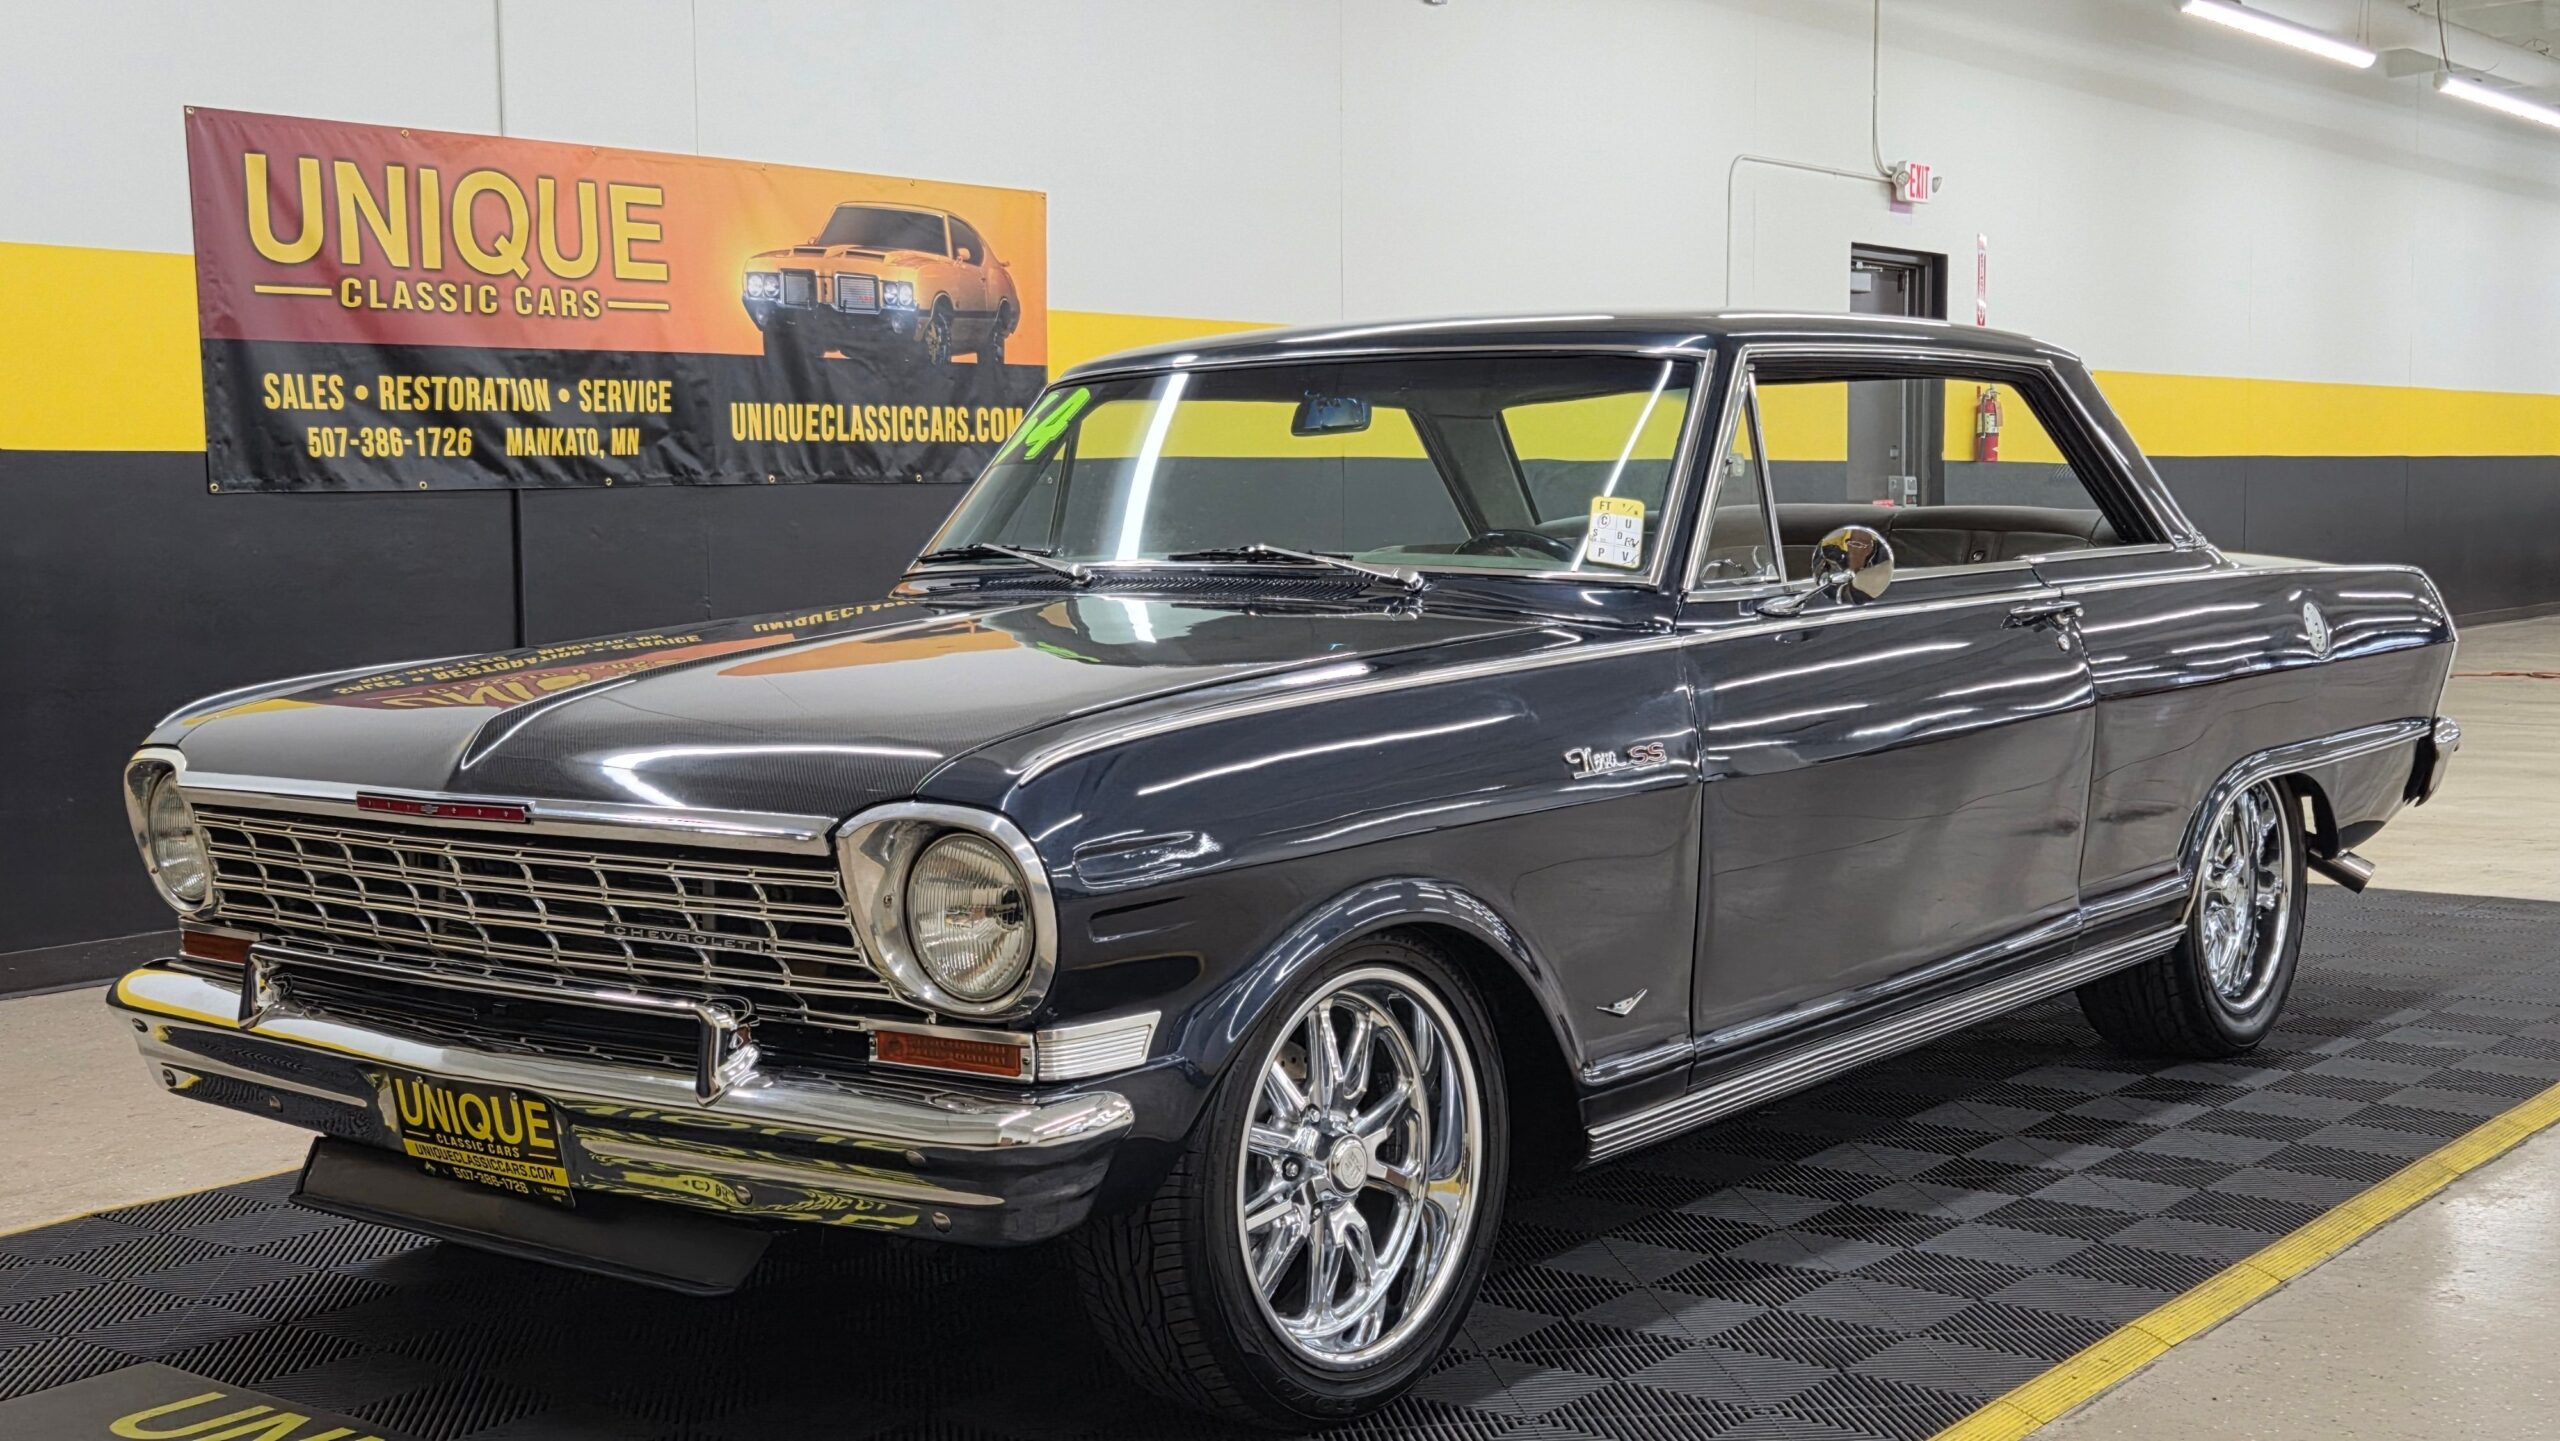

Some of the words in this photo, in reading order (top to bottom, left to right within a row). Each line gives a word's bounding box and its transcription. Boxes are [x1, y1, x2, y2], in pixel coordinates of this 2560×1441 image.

[1909, 163, 1930, 199] EXIT
[244, 153, 668, 281] UNIQUE
[341, 277, 498, 314] CLASSIC
[515, 287, 600, 318] CARS
[263, 373, 344, 410] SALES
[378, 375, 552, 412] RESTORATION
[579, 379, 672, 413] SERVICE
[307, 426, 472, 458] 507-386-1726
[611, 427, 640, 456] MN
[730, 402, 1024, 443] UNIQUECLASSICCARS.COM
[1629, 742, 1667, 765] SS
[612, 926, 752, 950] CHEVROLET
[395, 1078, 556, 1149] UNIQUE
[415, 1143, 556, 1182] UNIQUECLASSICCARS.COM
[436, 1133, 484, 1152] CLASSIC
[488, 1143, 521, 1158] CARS
